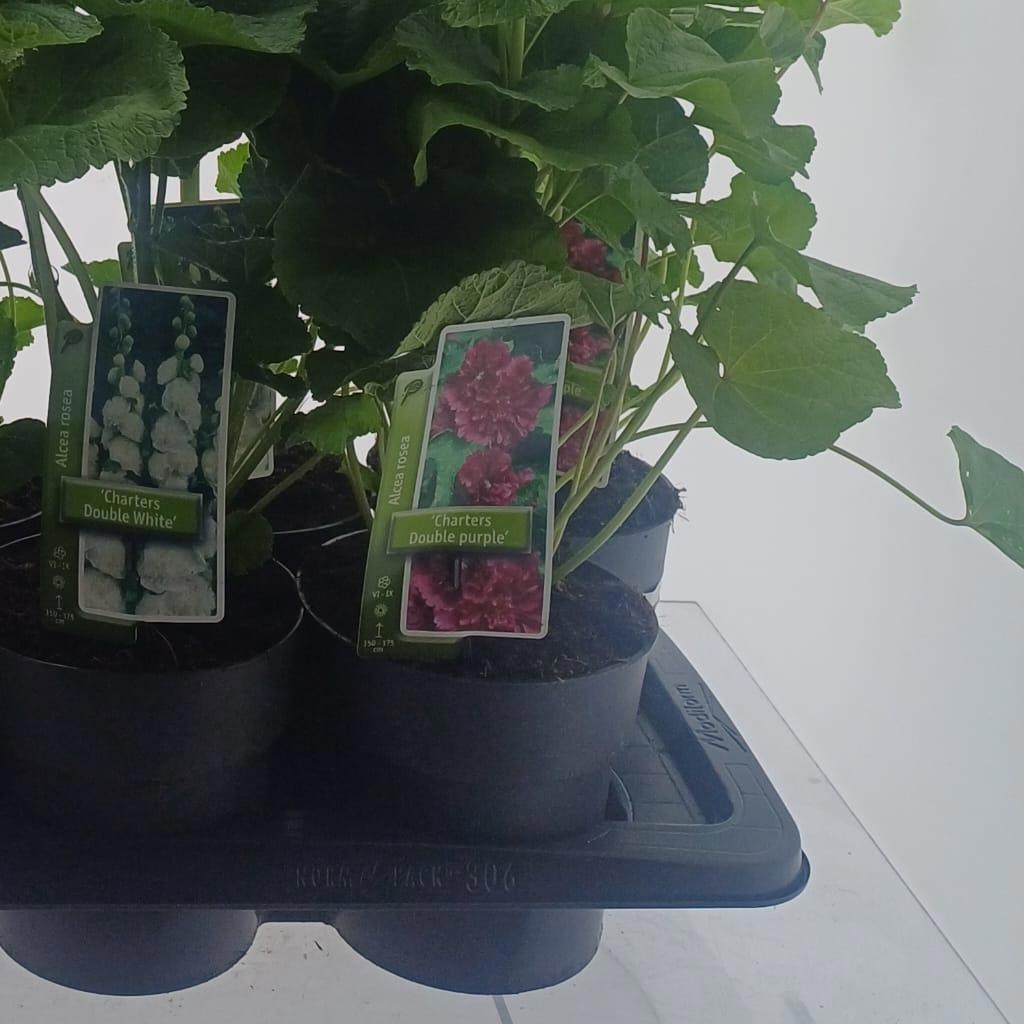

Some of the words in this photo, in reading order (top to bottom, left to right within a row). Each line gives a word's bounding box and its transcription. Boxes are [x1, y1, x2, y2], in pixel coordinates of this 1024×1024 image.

[61, 389, 73, 426] rosea
[55, 430, 70, 469] Alcea
[388, 472, 405, 505] Alcea
[397, 435, 410, 470] rosea
[83, 503, 130, 523] Double
[409, 530, 456, 545] Double
